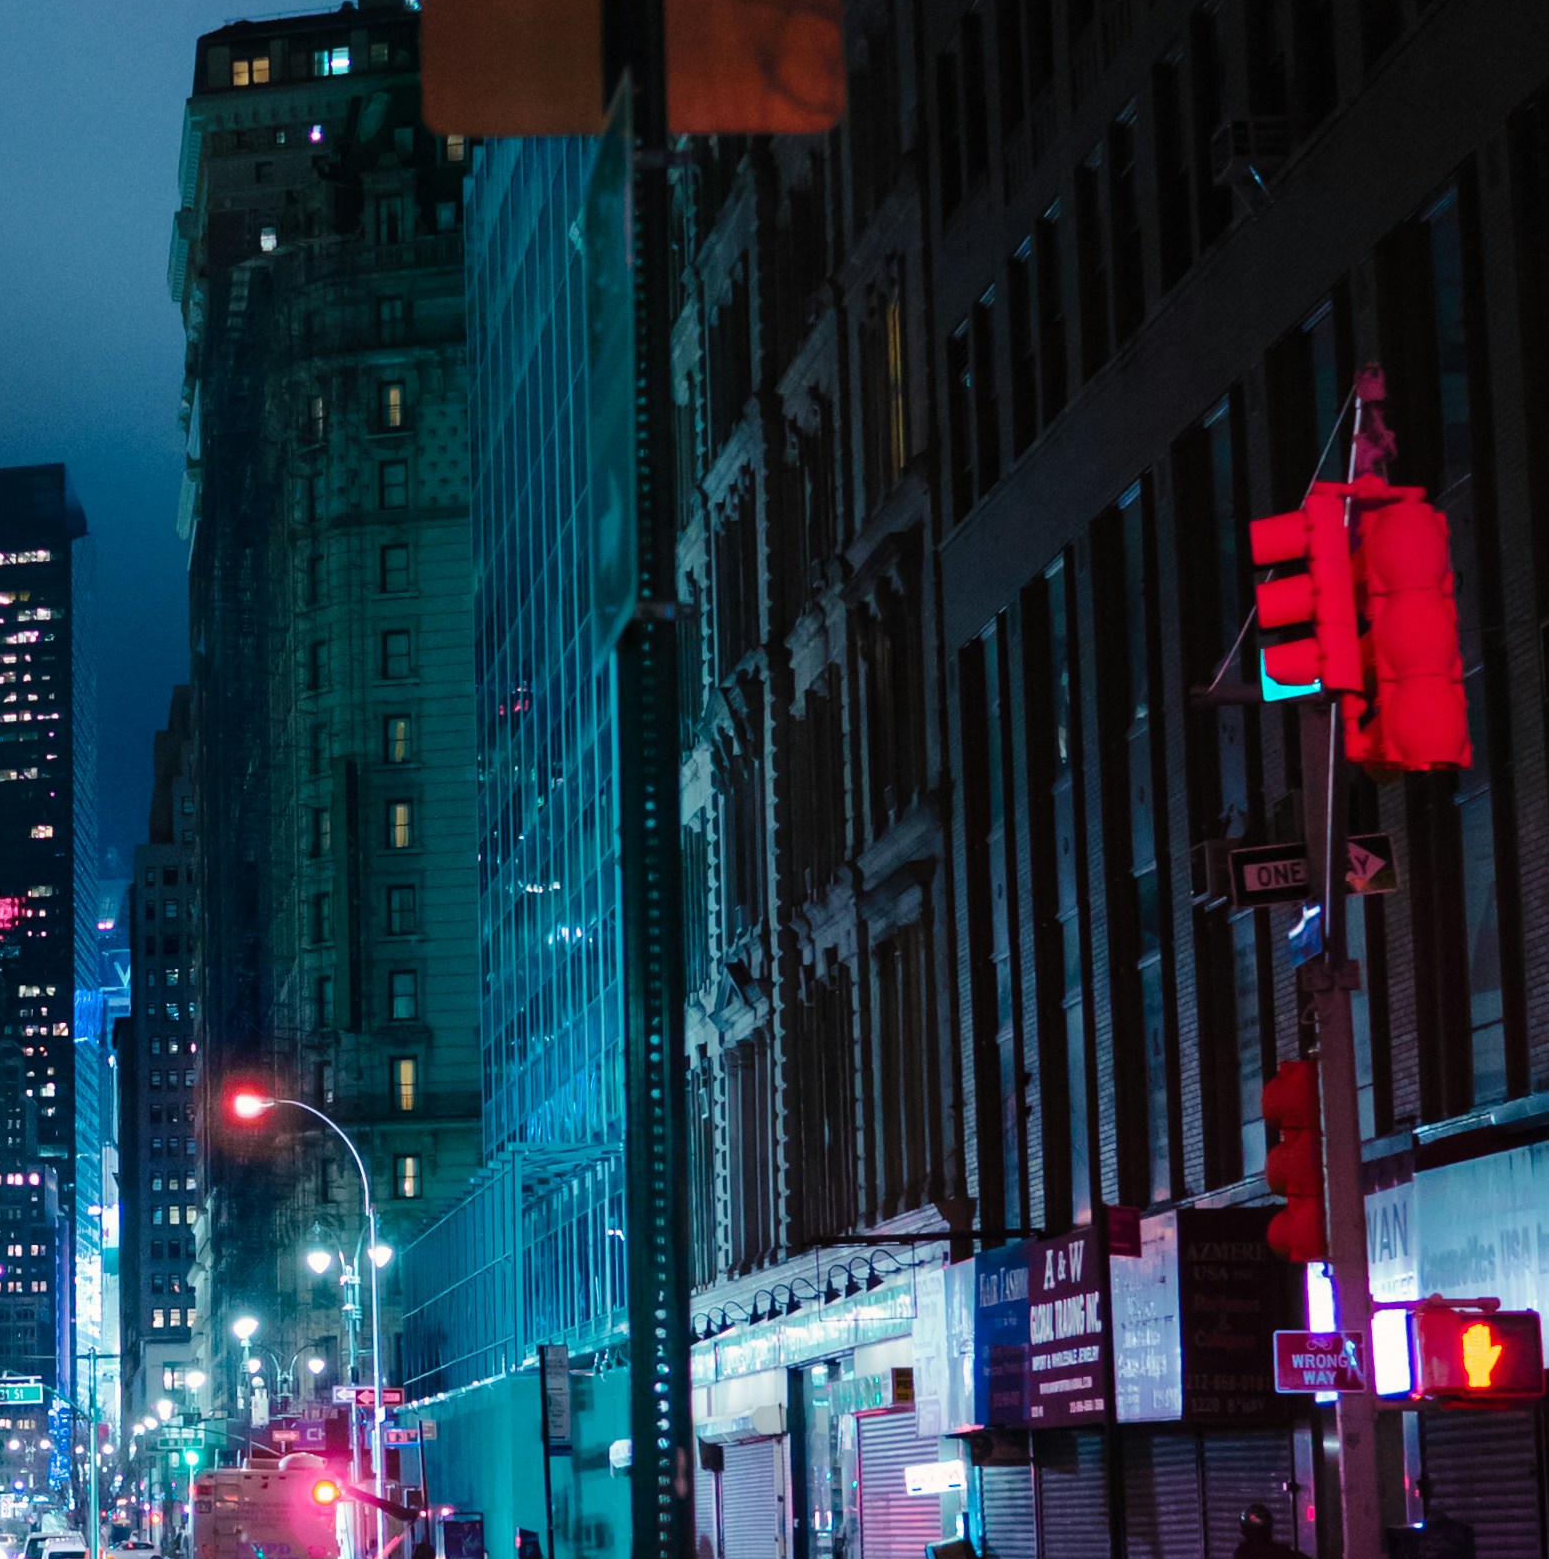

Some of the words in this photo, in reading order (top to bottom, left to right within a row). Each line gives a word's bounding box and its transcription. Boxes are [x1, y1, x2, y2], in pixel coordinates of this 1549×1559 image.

[1257, 862, 1303, 887] ONE
[1043, 1249, 1056, 1290] A
[1057, 1250, 1067, 1281] &
[1068, 1240, 1085, 1283] W
[1193, 1265, 1229, 1281] USA
[1291, 1353, 1350, 1369] WRONG
[1302, 1370, 1338, 1386] WAY
